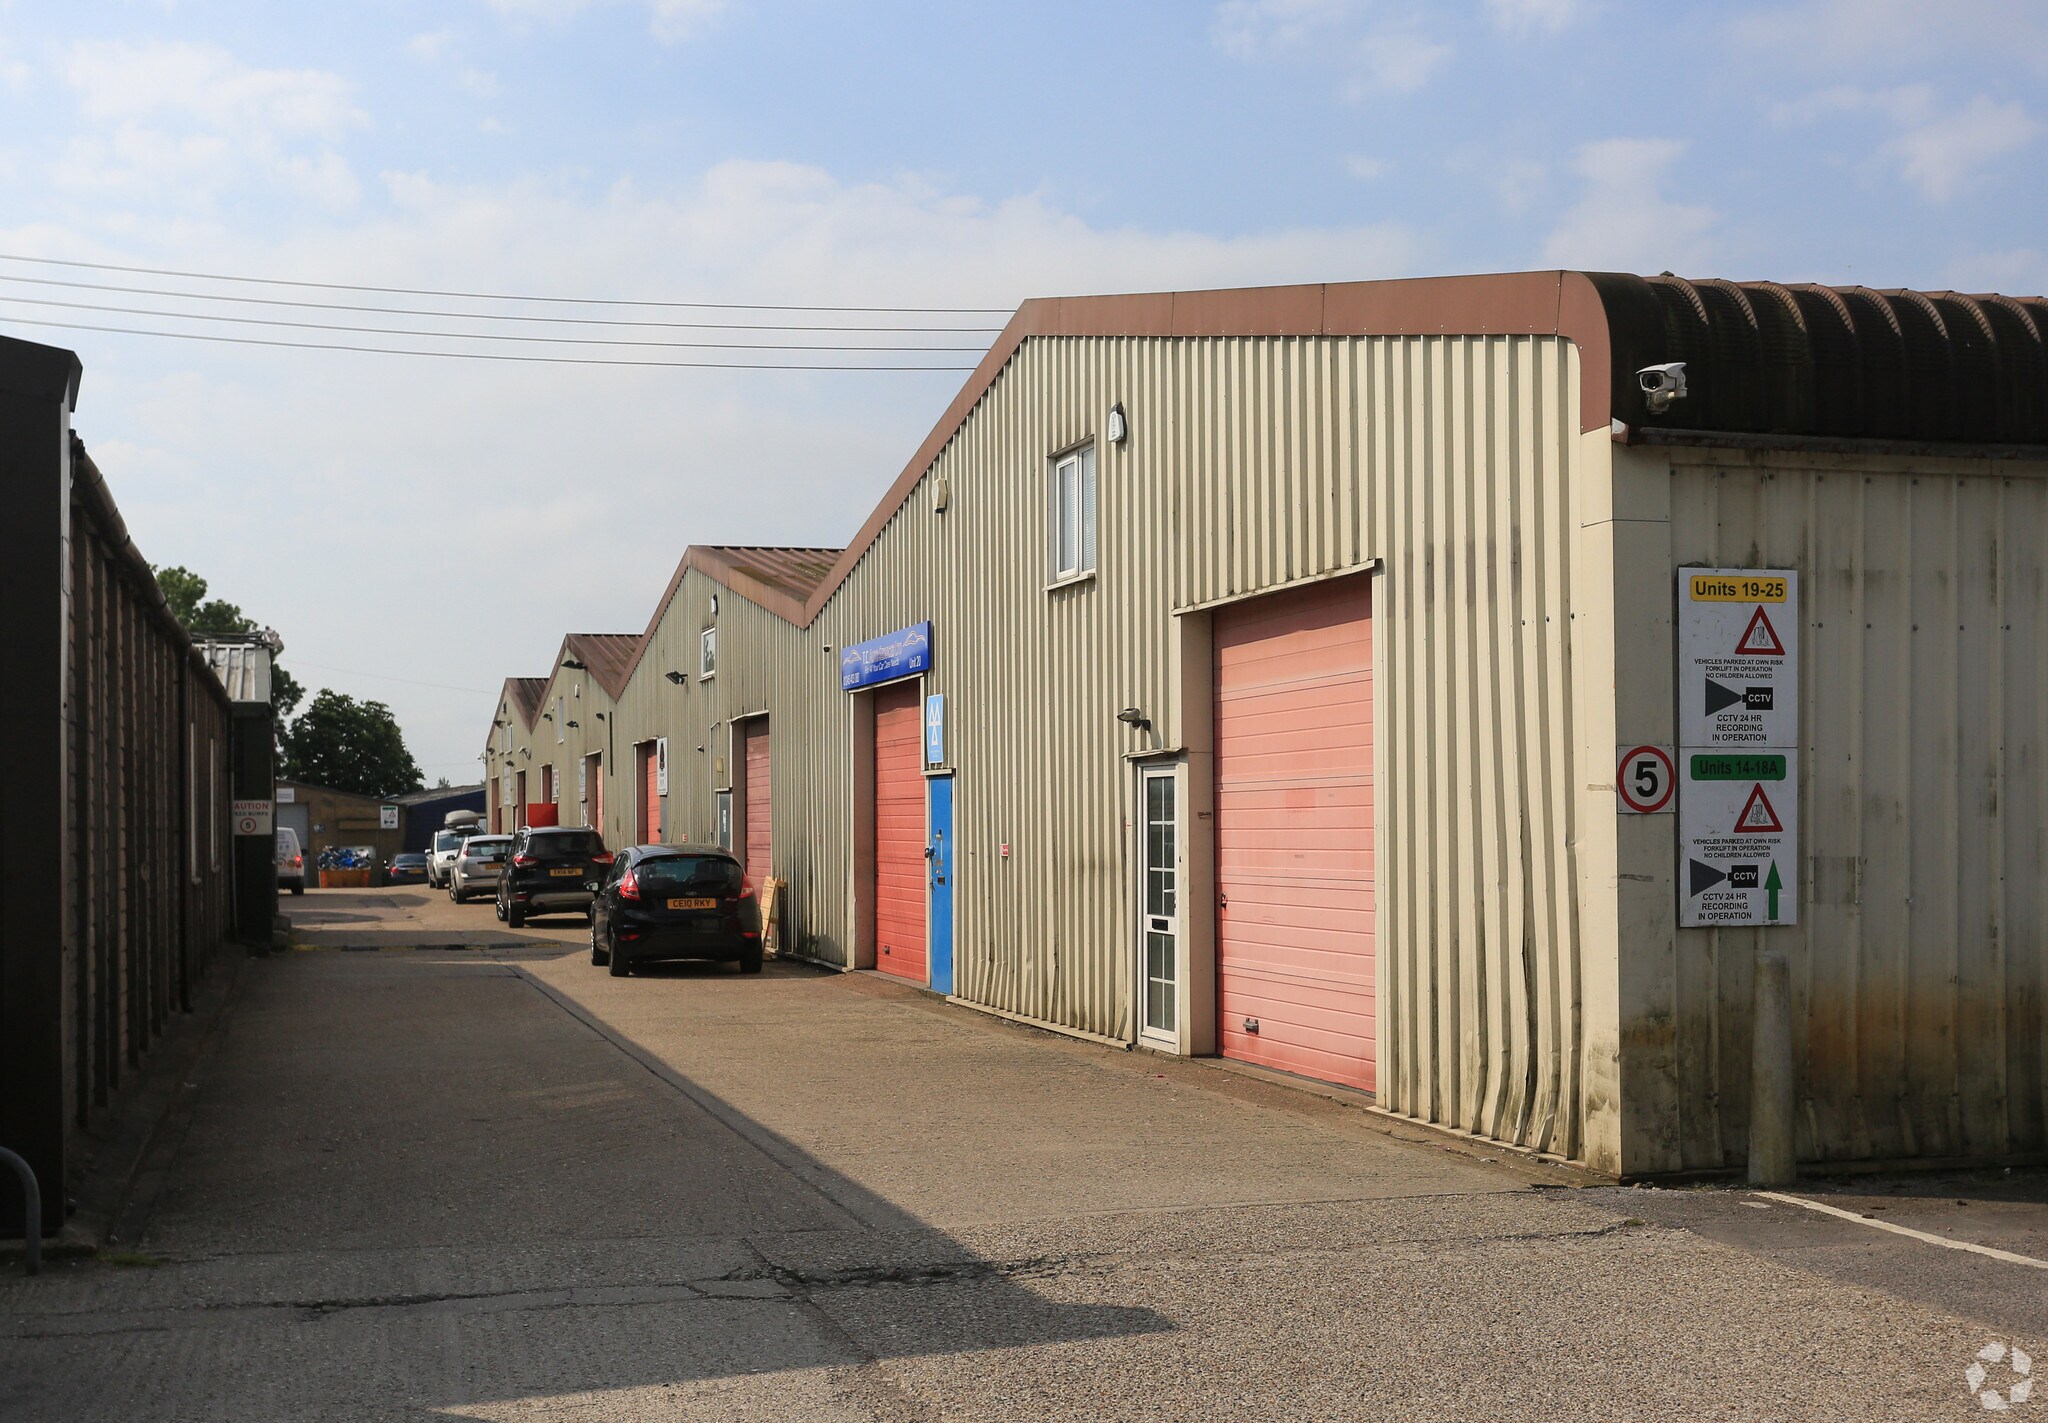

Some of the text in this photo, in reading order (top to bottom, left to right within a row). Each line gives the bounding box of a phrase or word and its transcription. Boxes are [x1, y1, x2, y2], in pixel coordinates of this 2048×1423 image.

[1695, 581, 1784, 597] Units 19-25
[1748, 694, 1771, 702] CCTV
[1700, 760, 1778, 775] Units 14-18A
[1635, 761, 1658, 798] 5
[245, 821, 251, 829] 5
[1733, 872, 1757, 880] CCTV
[1702, 893, 1724, 901] CCTV
[672, 899, 711, 908] CE10 RKY
[1702, 903, 1748, 911] RECORDING
[1707, 912, 1752, 920] OPERATION
